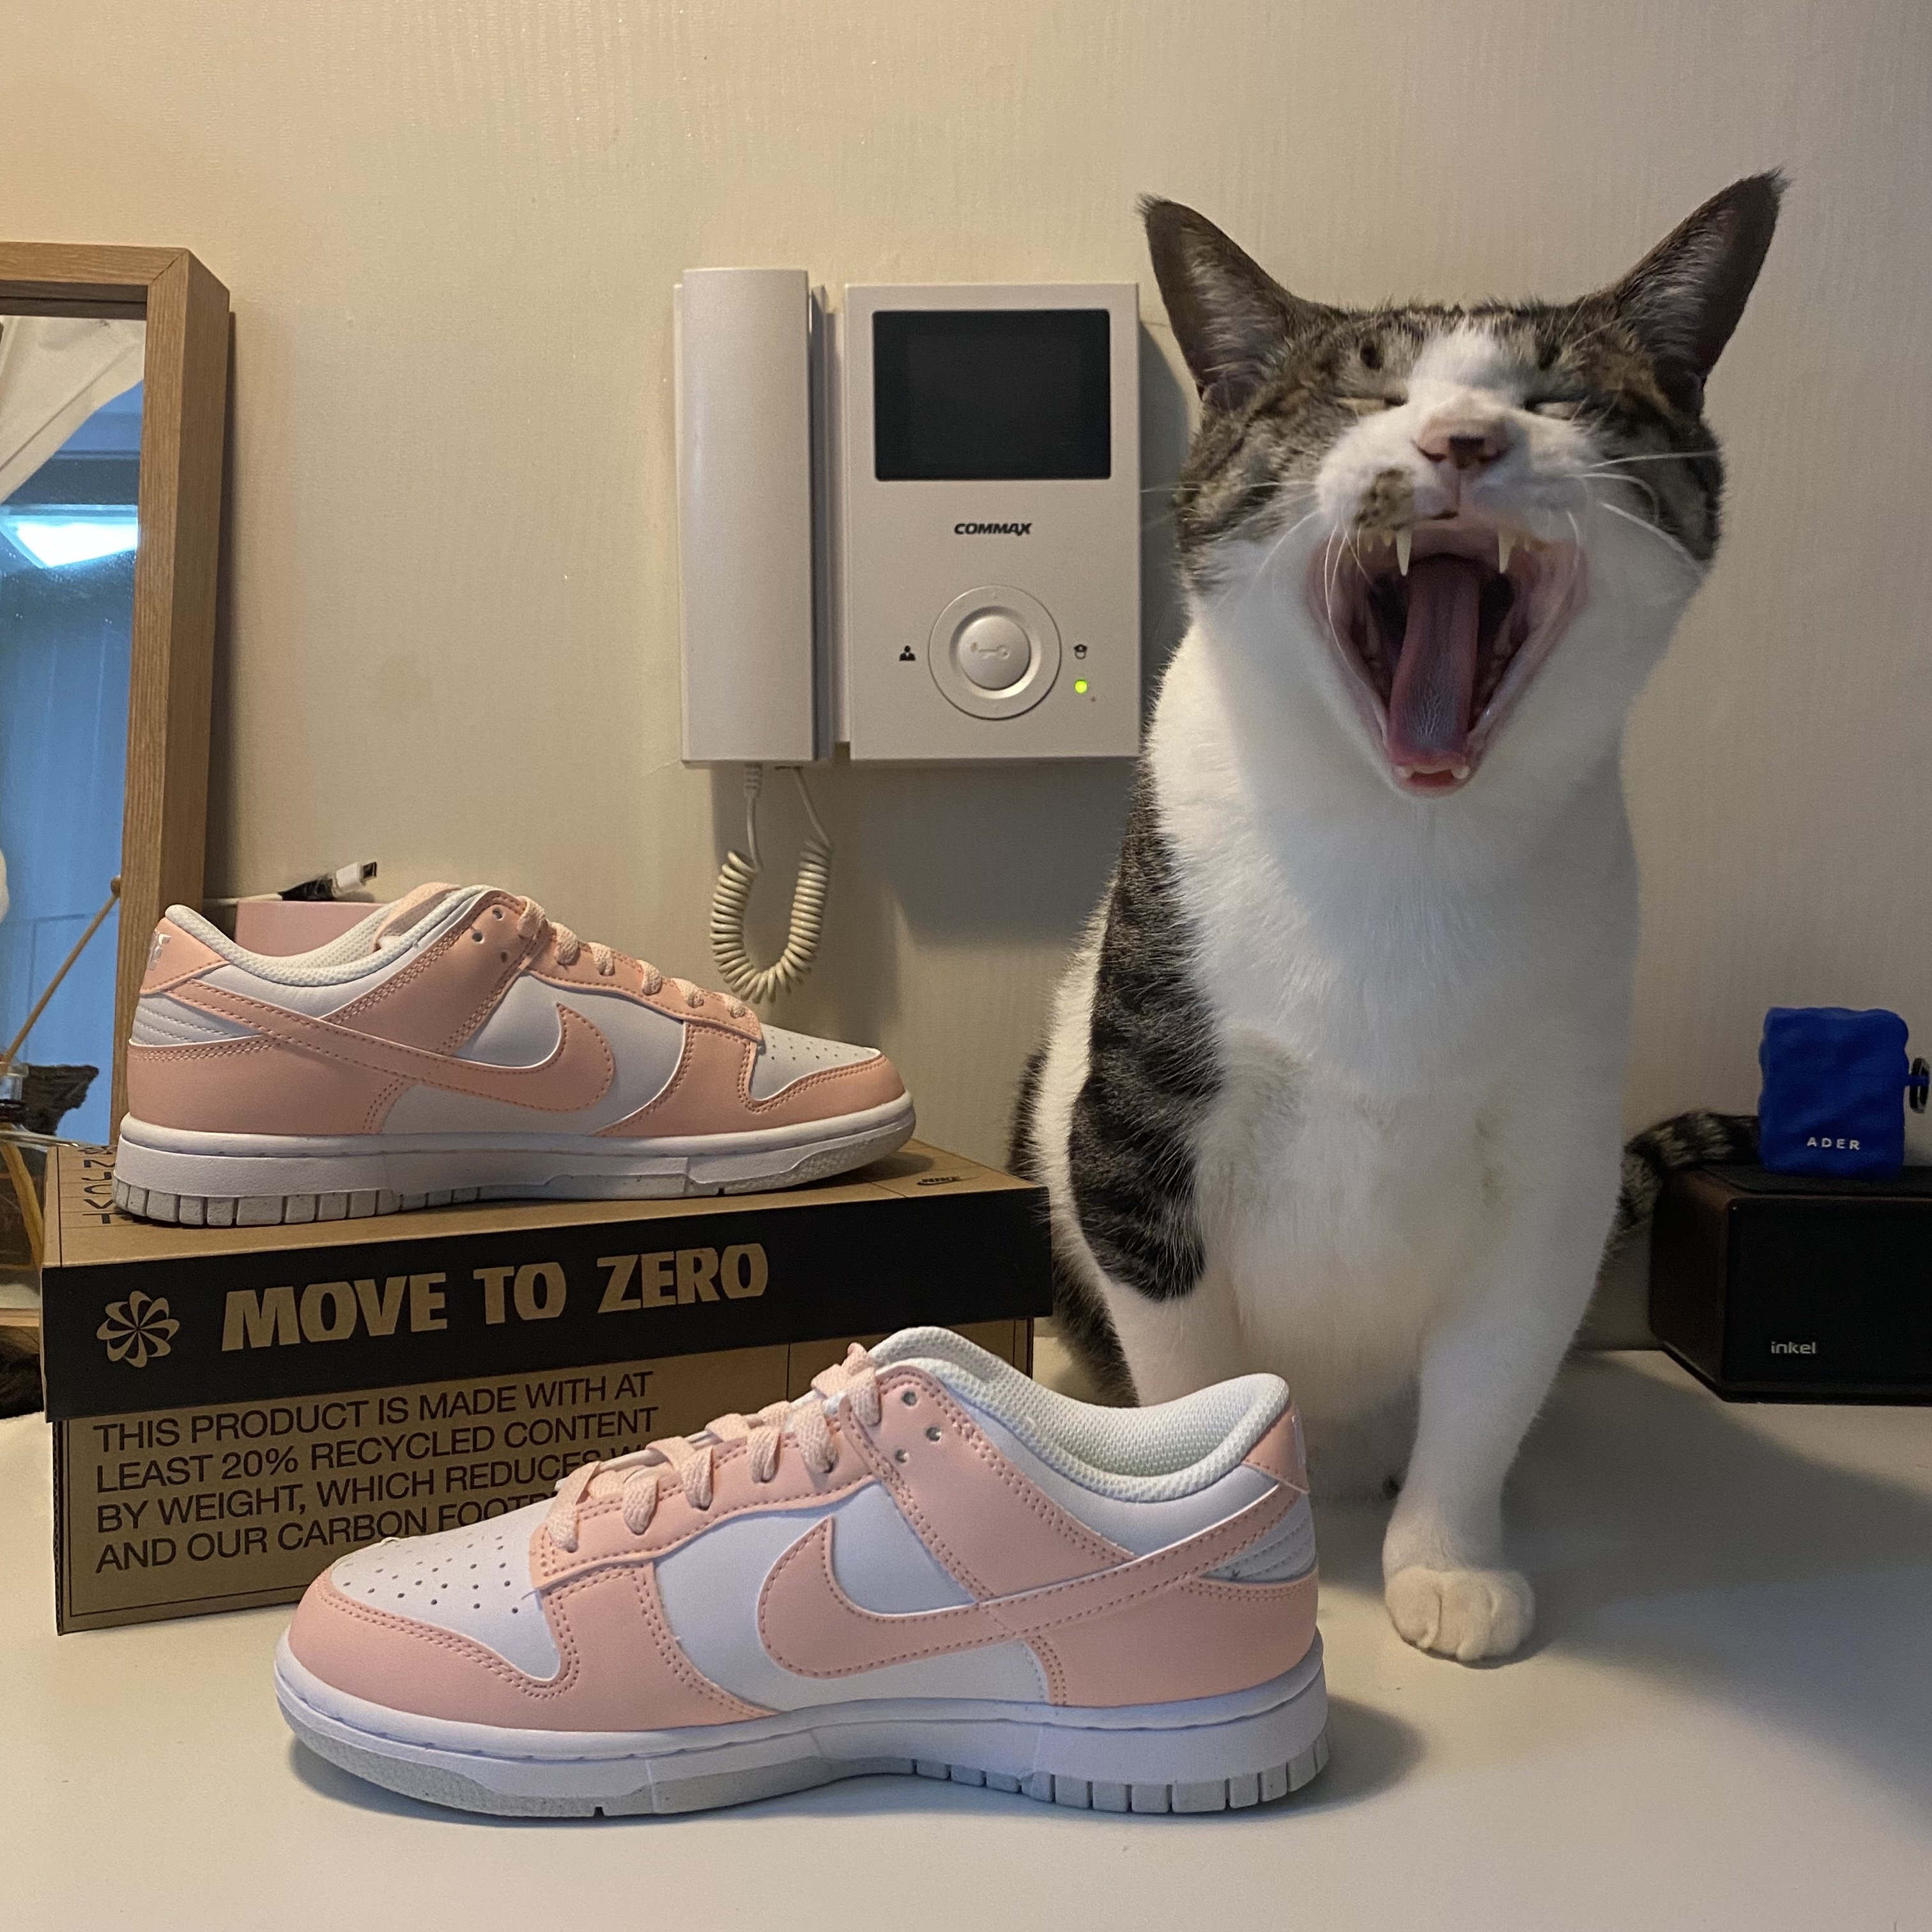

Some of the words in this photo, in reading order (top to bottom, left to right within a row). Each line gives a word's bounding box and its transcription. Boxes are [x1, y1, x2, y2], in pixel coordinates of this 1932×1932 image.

[954, 523, 1032, 536] COMMAX
[1806, 1137, 1860, 1151] ADER
[222, 1273, 447, 1351] MOVE
[473, 1262, 566, 1325] TO
[597, 1243, 769, 1314] ZERO
[1770, 1341, 1816, 1354] inkel
[93, 1418, 180, 1452] THIS
[191, 1400, 369, 1443] PRODUCT
[378, 1396, 409, 1425] IS
[419, 1385, 517, 1421] MADE
[525, 1376, 606, 1409] WITH
[614, 1371, 654, 1400] AT
[97, 1454, 213, 1493] LEAST
[222, 1445, 298, 1479] 20%
[311, 1425, 495, 1470] RECYCLED
[504, 1407, 659, 1448] CONTENT
[97, 1500, 148, 1533] BY
[158, 1483, 306, 1525] WEIGHT,
[317, 1469, 434, 1507] WHICH
[96, 1538, 176, 1573] AND
[187, 1526, 267, 1561] OUR
[278, 1507, 427, 1551] CARBON
